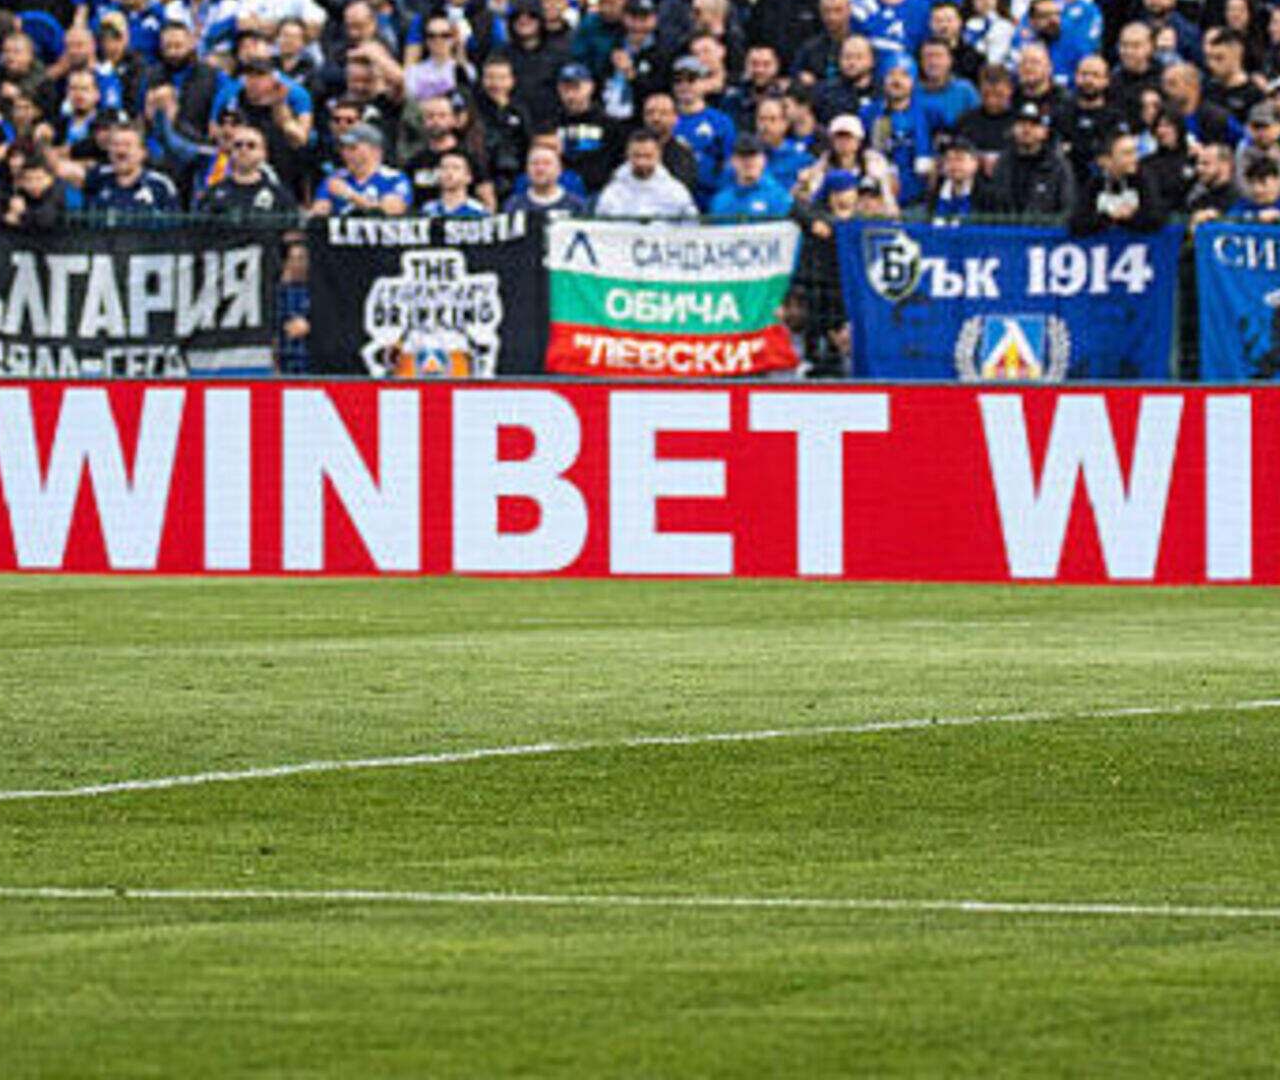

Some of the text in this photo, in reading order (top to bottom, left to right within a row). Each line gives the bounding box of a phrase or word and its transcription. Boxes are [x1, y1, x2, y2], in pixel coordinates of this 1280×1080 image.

[329, 210, 526, 246] LEVSKI SOFIA
[410, 258, 458, 281] THE
[631, 237, 781, 270] САНДАНСКИ
[1027, 243, 1154, 297] 1914
[605, 287, 742, 325] ОБИЧА
[573, 332, 766, 371] "ЛЕВСКИ"
